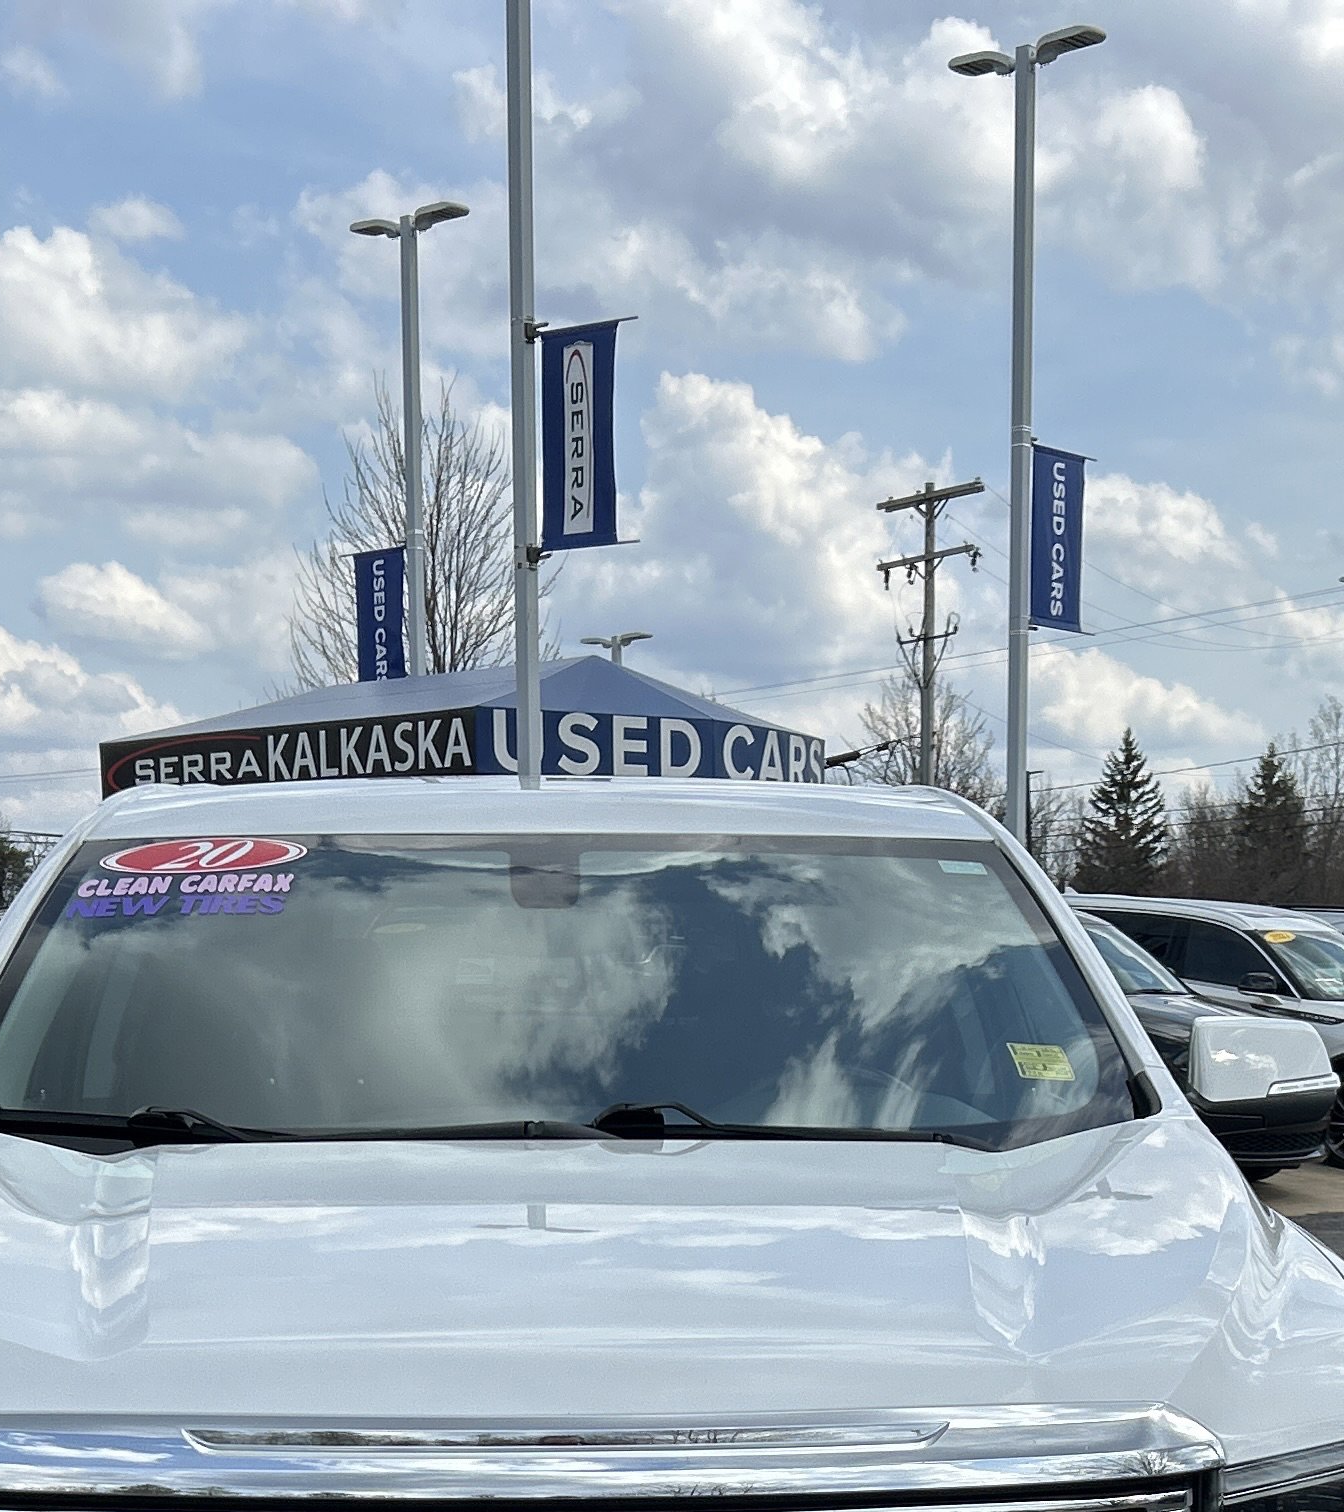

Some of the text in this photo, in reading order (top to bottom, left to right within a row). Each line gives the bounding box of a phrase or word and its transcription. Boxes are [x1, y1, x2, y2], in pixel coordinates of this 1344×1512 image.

[570, 382, 584, 521] SERRA
[1050, 462, 1066, 617] USED CARS
[372, 559, 386, 622] USED
[134, 717, 472, 786] SERRA KALKASKA
[492, 708, 824, 784] USED CARS
[77, 873, 295, 898] CLEAN CARFAX
[151, 840, 254, 871] 20
[65, 895, 287, 919] NEW TIRES
